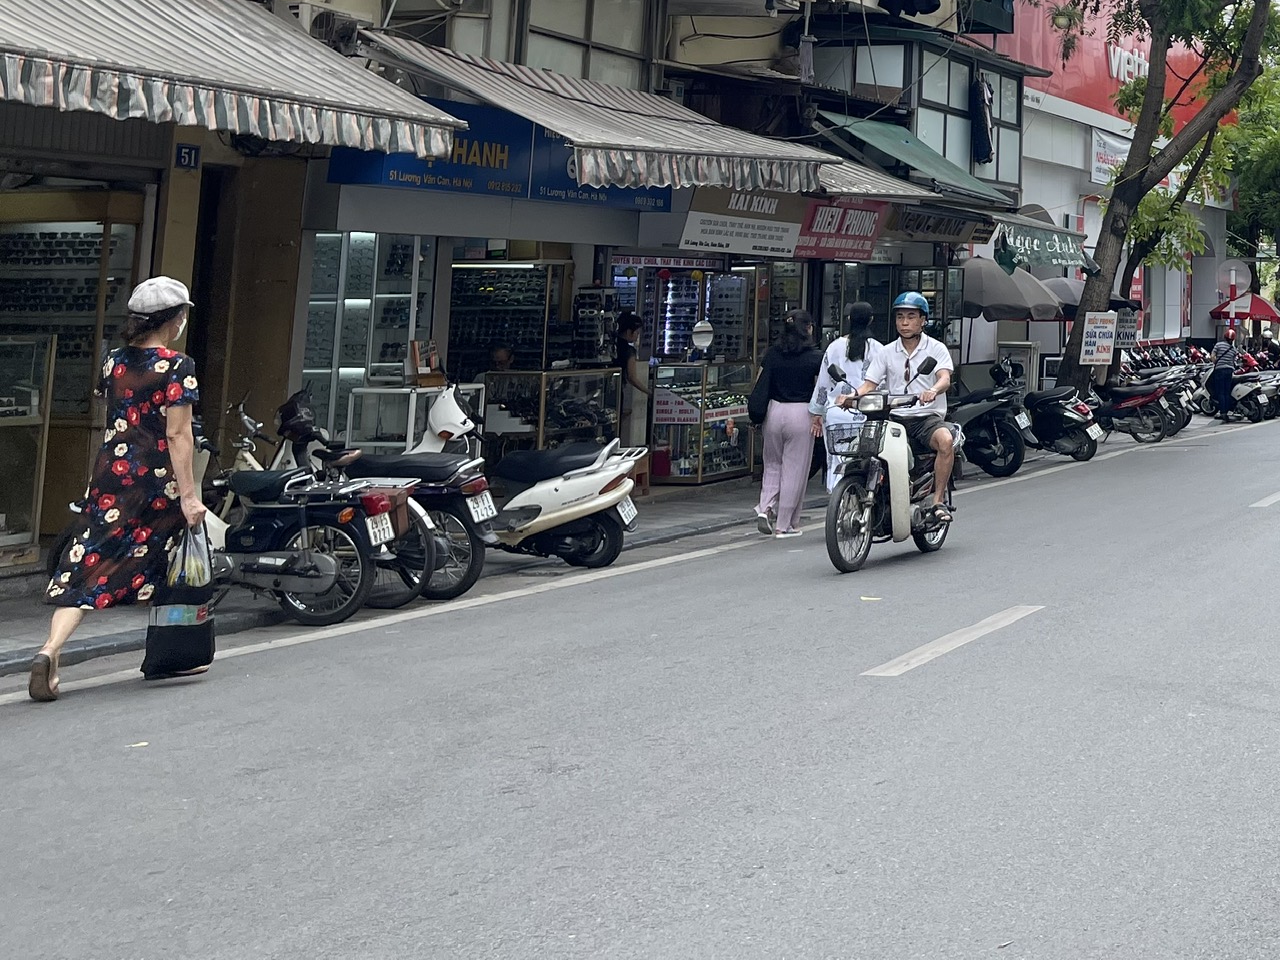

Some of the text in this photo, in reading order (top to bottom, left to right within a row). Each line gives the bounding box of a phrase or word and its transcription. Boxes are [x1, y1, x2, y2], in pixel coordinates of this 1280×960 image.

[181, 148, 196, 166] 51
[389, 169, 398, 181] 51
[399, 170, 421, 186] Lương
[423, 172, 436, 185] Văn
[539, 186, 547, 195] 51
[547, 186, 566, 200] Lương
[567, 189, 578, 199] Văn
[749, 192, 779, 215] KÍNH
[841, 208, 880, 238] PHONG
[998, 222, 1042, 255] Ngọc
[1045, 233, 1083, 255] Anh
[1085, 329, 1114, 339] SỬA CHỮA
[1096, 343, 1111, 354] KÍNH
